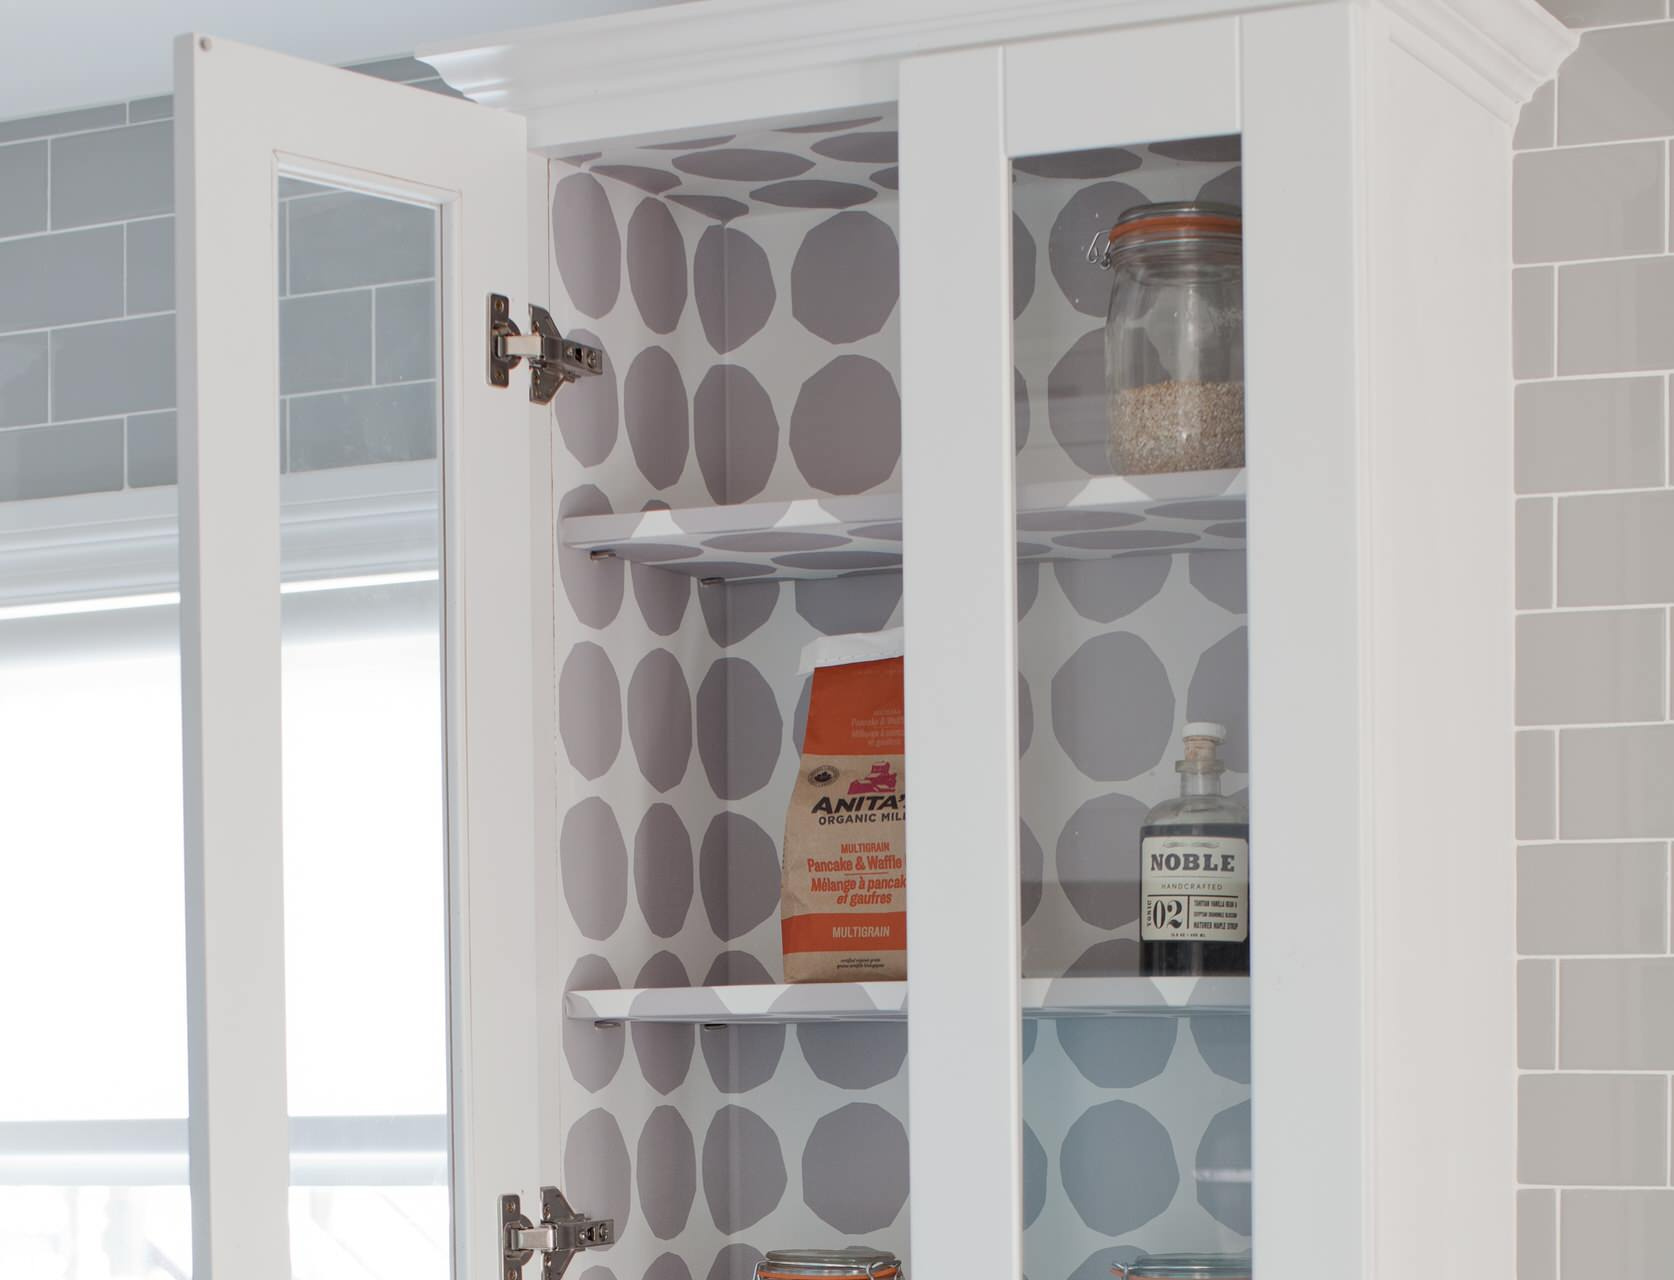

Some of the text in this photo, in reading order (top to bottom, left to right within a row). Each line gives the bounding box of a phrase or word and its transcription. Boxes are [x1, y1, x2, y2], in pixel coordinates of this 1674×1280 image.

[811, 794, 905, 814] ANITA'
[818, 813, 877, 825] ORGANIC
[840, 842, 890, 854] MULTIGRAIN
[807, 855, 902, 872] Pancake & Waffle
[1150, 853, 1235, 872] NOBLE
[811, 877, 857, 893] Mélange
[867, 874, 906, 892] pancak
[1161, 882, 1223, 891] HANDCRAFTED
[849, 891, 893, 907] gaufres
[1153, 900, 1183, 929] 02
[832, 926, 890, 938] MULTIGRAIN
